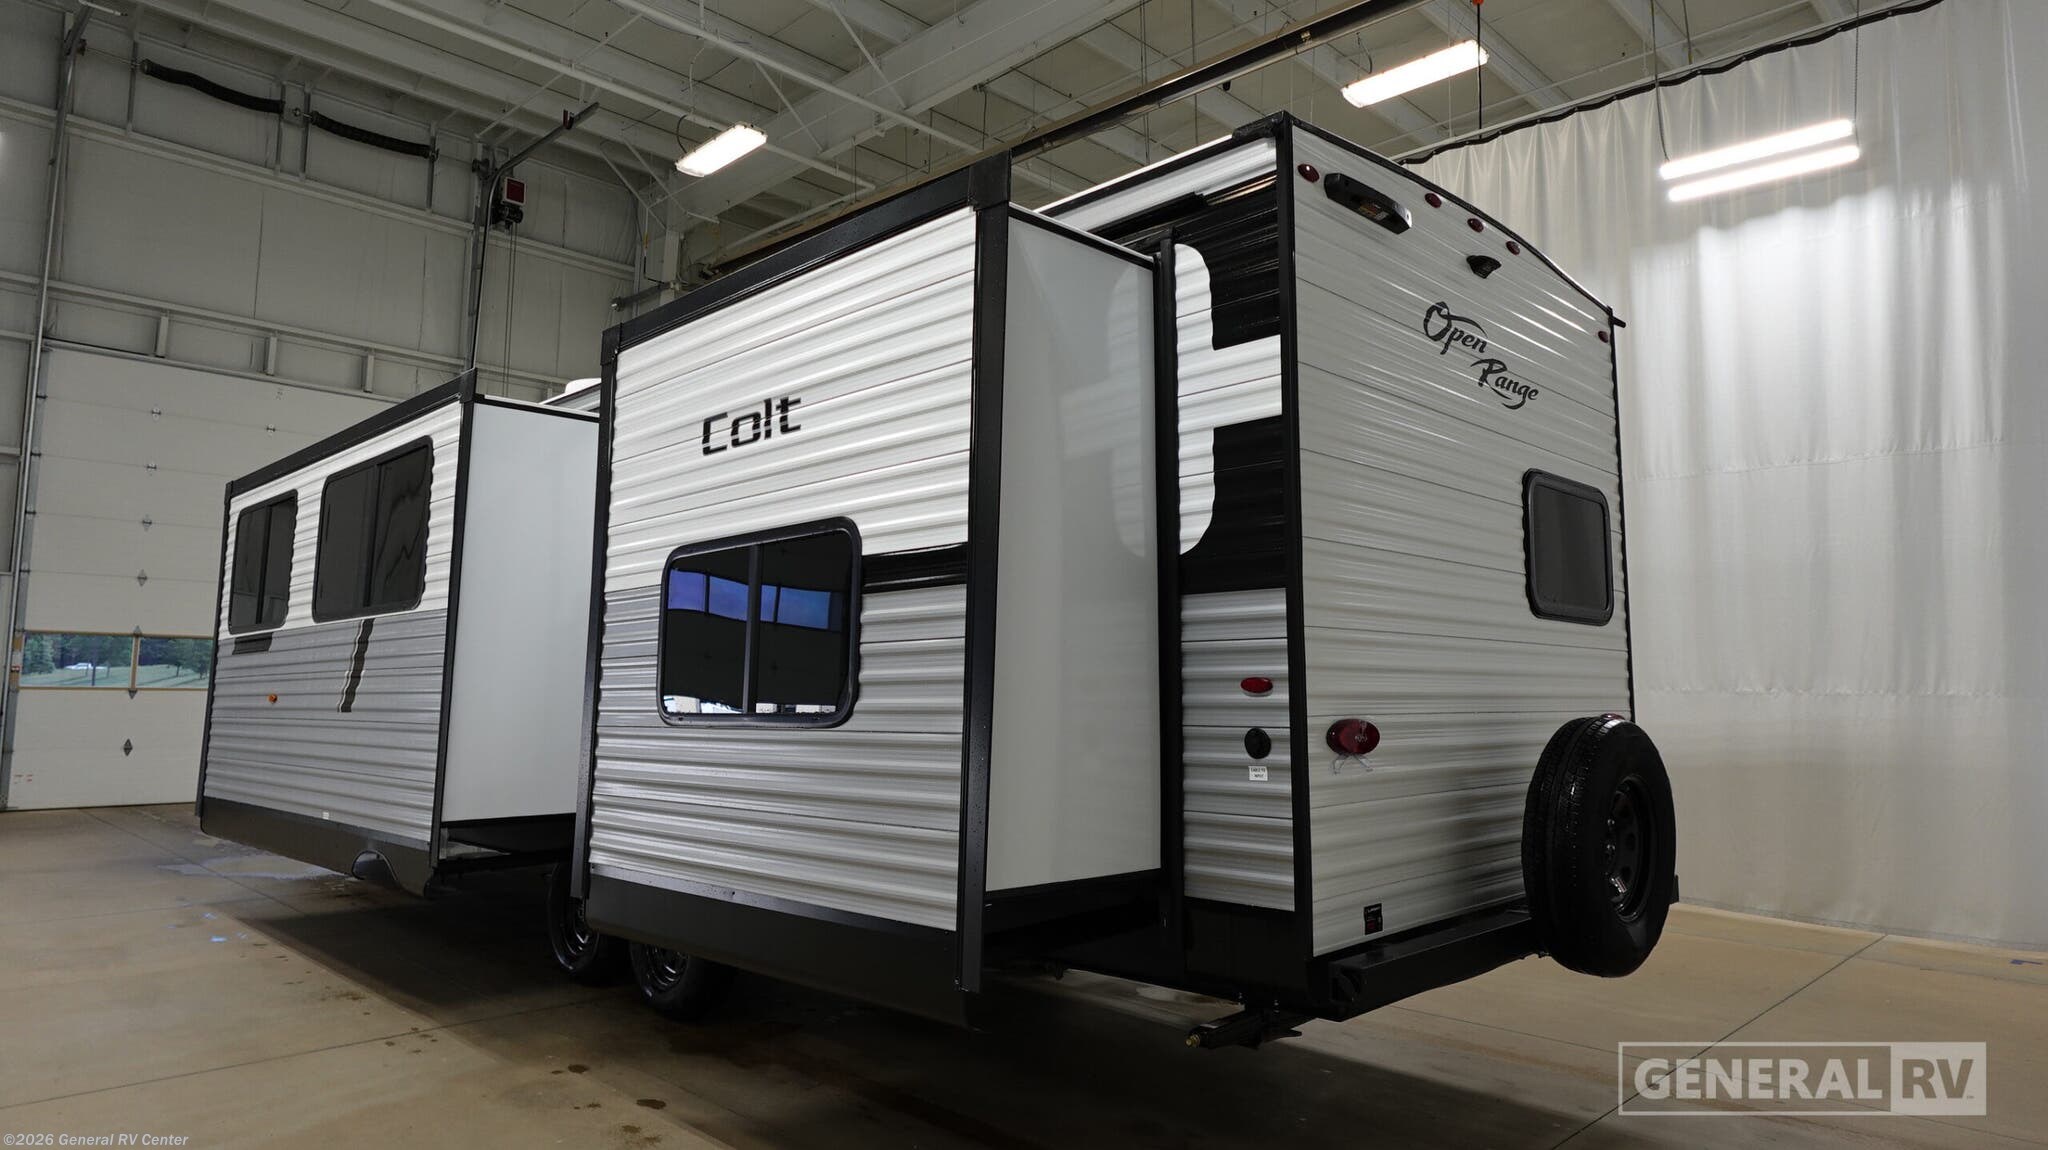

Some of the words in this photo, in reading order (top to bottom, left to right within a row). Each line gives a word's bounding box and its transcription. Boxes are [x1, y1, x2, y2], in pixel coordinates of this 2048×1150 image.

[1423, 301, 1488, 355] Open
[1470, 358, 1539, 410] Range
[702, 396, 801, 456] Colt
